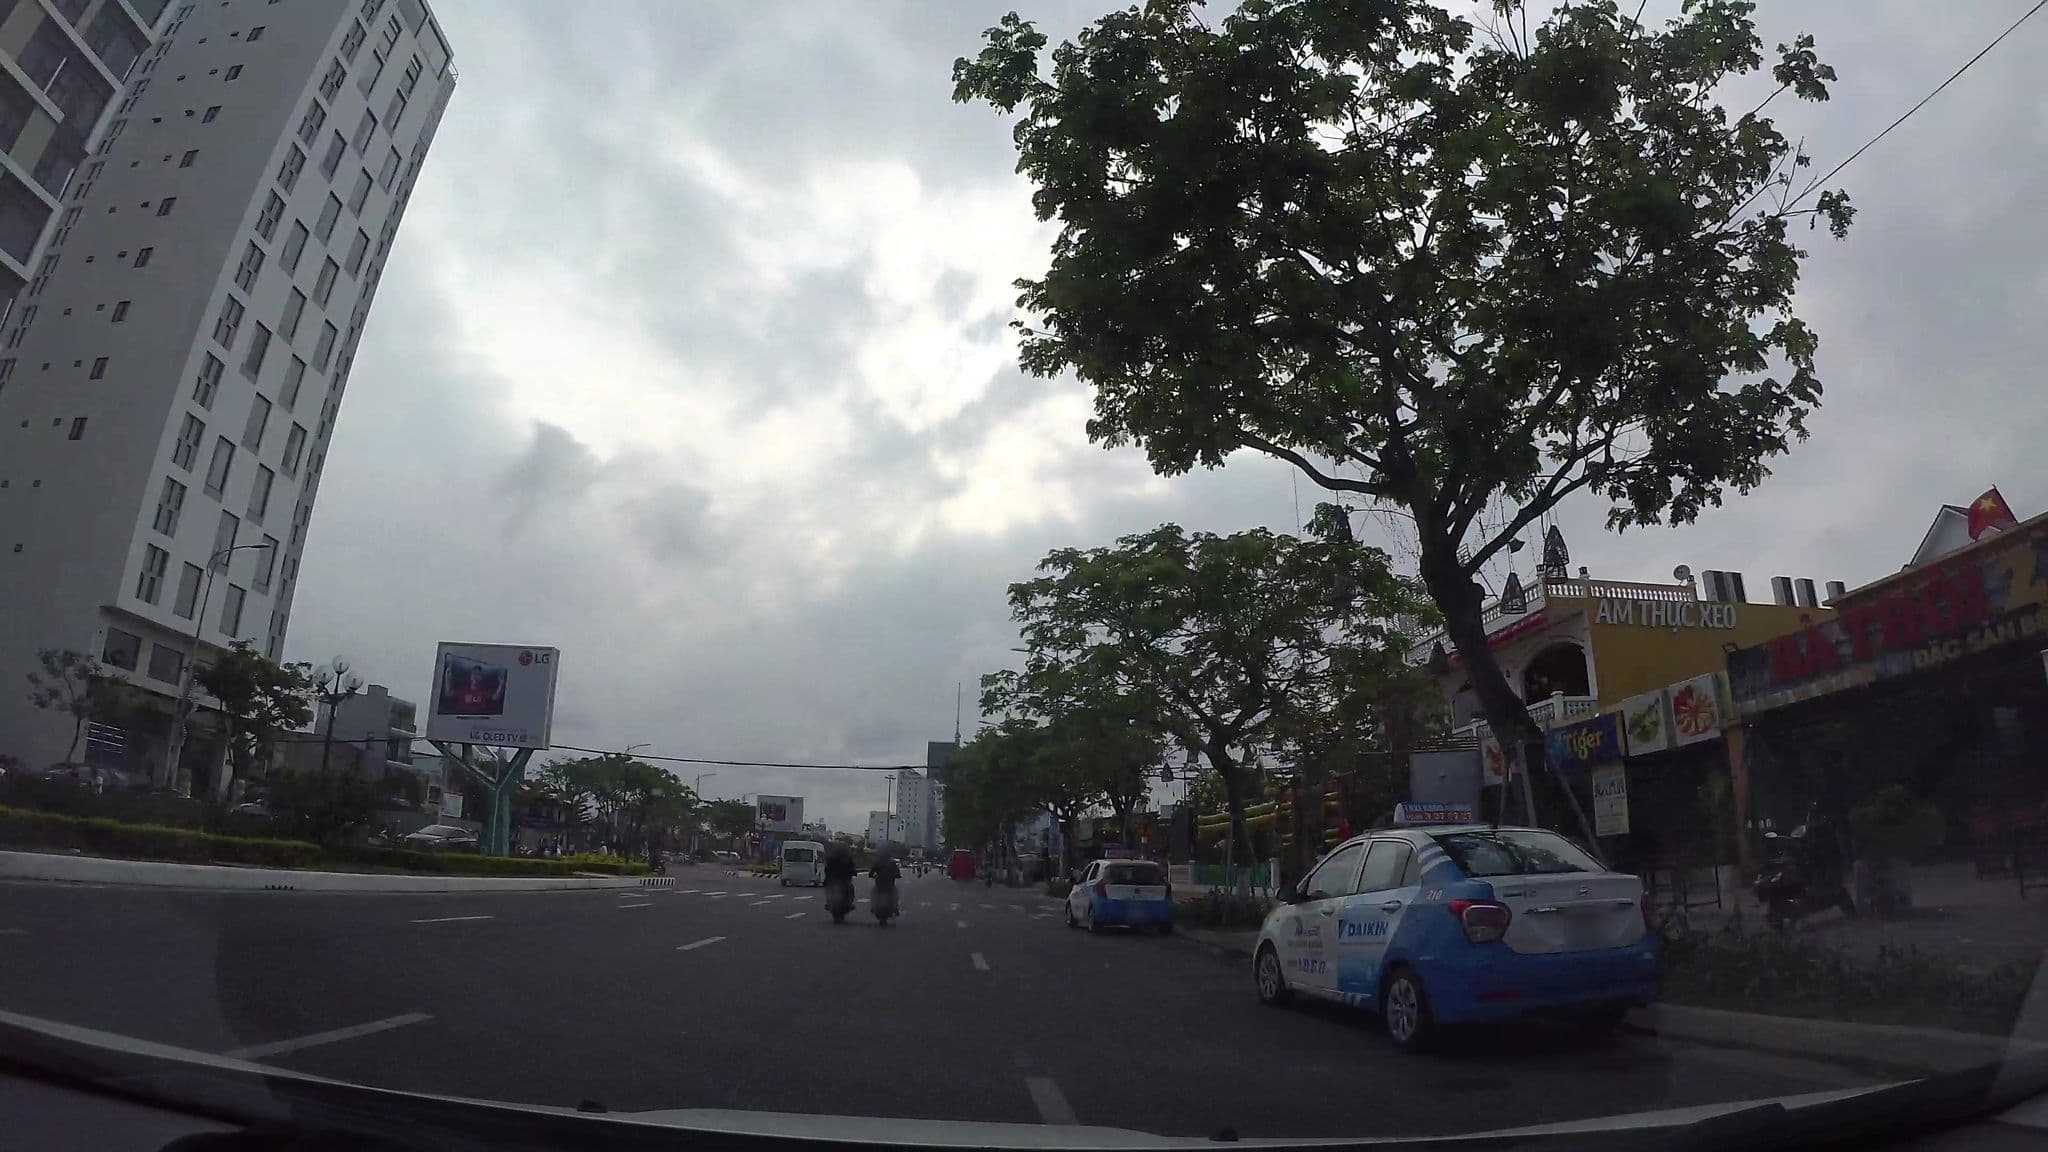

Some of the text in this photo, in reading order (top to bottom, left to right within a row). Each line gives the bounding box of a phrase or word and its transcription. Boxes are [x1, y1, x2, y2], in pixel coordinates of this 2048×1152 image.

[534, 653, 550, 665] LG
[483, 732, 506, 742] OLED
[1561, 728, 1602, 760] Tiger
[1347, 922, 1388, 937] DAIKIN
